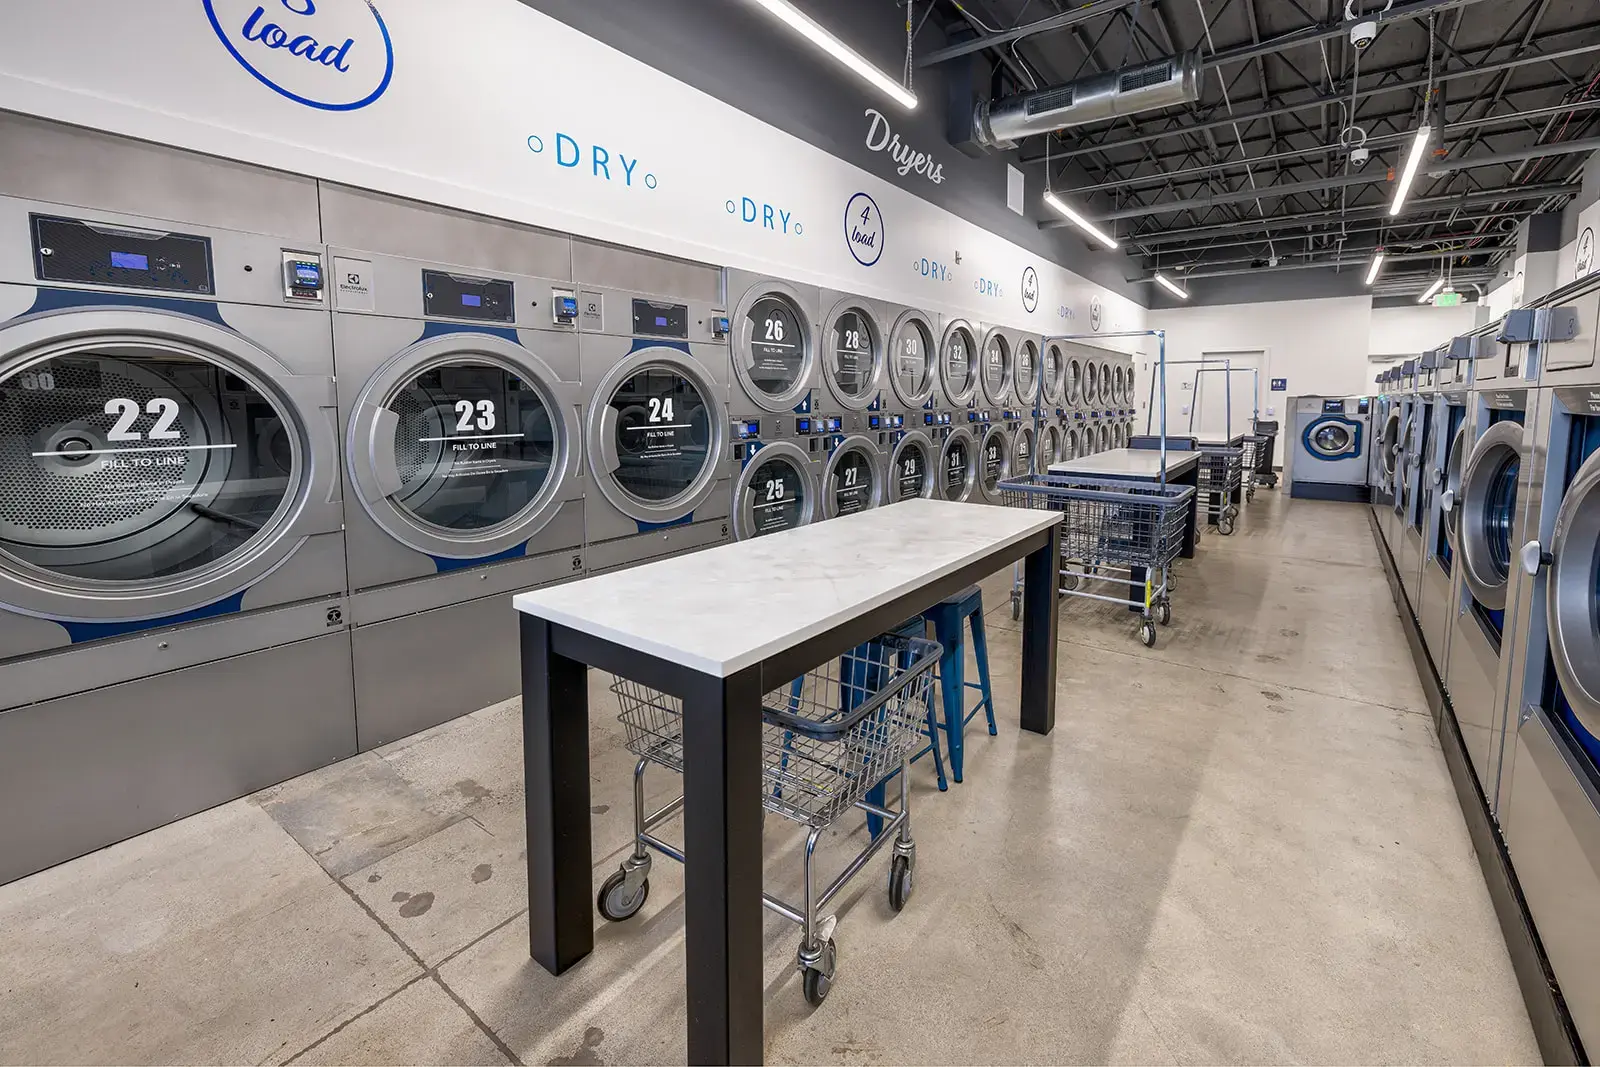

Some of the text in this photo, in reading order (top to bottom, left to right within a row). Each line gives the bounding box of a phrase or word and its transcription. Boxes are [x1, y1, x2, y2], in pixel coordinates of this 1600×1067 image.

[242, 6, 354, 73] load
[864, 108, 945, 184] Dryers
[556, 132, 637, 186] DRY
[743, 196, 791, 234] DRY
[860, 205, 870, 226] 4
[851, 225, 876, 248] load
[921, 258, 947, 281] DRY
[980, 277, 999, 297] DRY
[1027, 274, 1034, 287] 4
[765, 318, 783, 341] 26
[845, 330, 859, 349] 28
[906, 338, 917, 355] 30
[953, 344, 962, 360] 32
[991, 349, 999, 363] 34
[104, 397, 181, 442] 22
[455, 399, 496, 432] 23
[648, 397, 674, 423] 24
[101, 456, 185, 469] FILL TO LINE
[951, 452, 960, 467] 31
[988, 446, 997, 460] 33
[845, 467, 857, 487] 27
[904, 458, 916, 476] 29
[766, 478, 784, 501] 25
